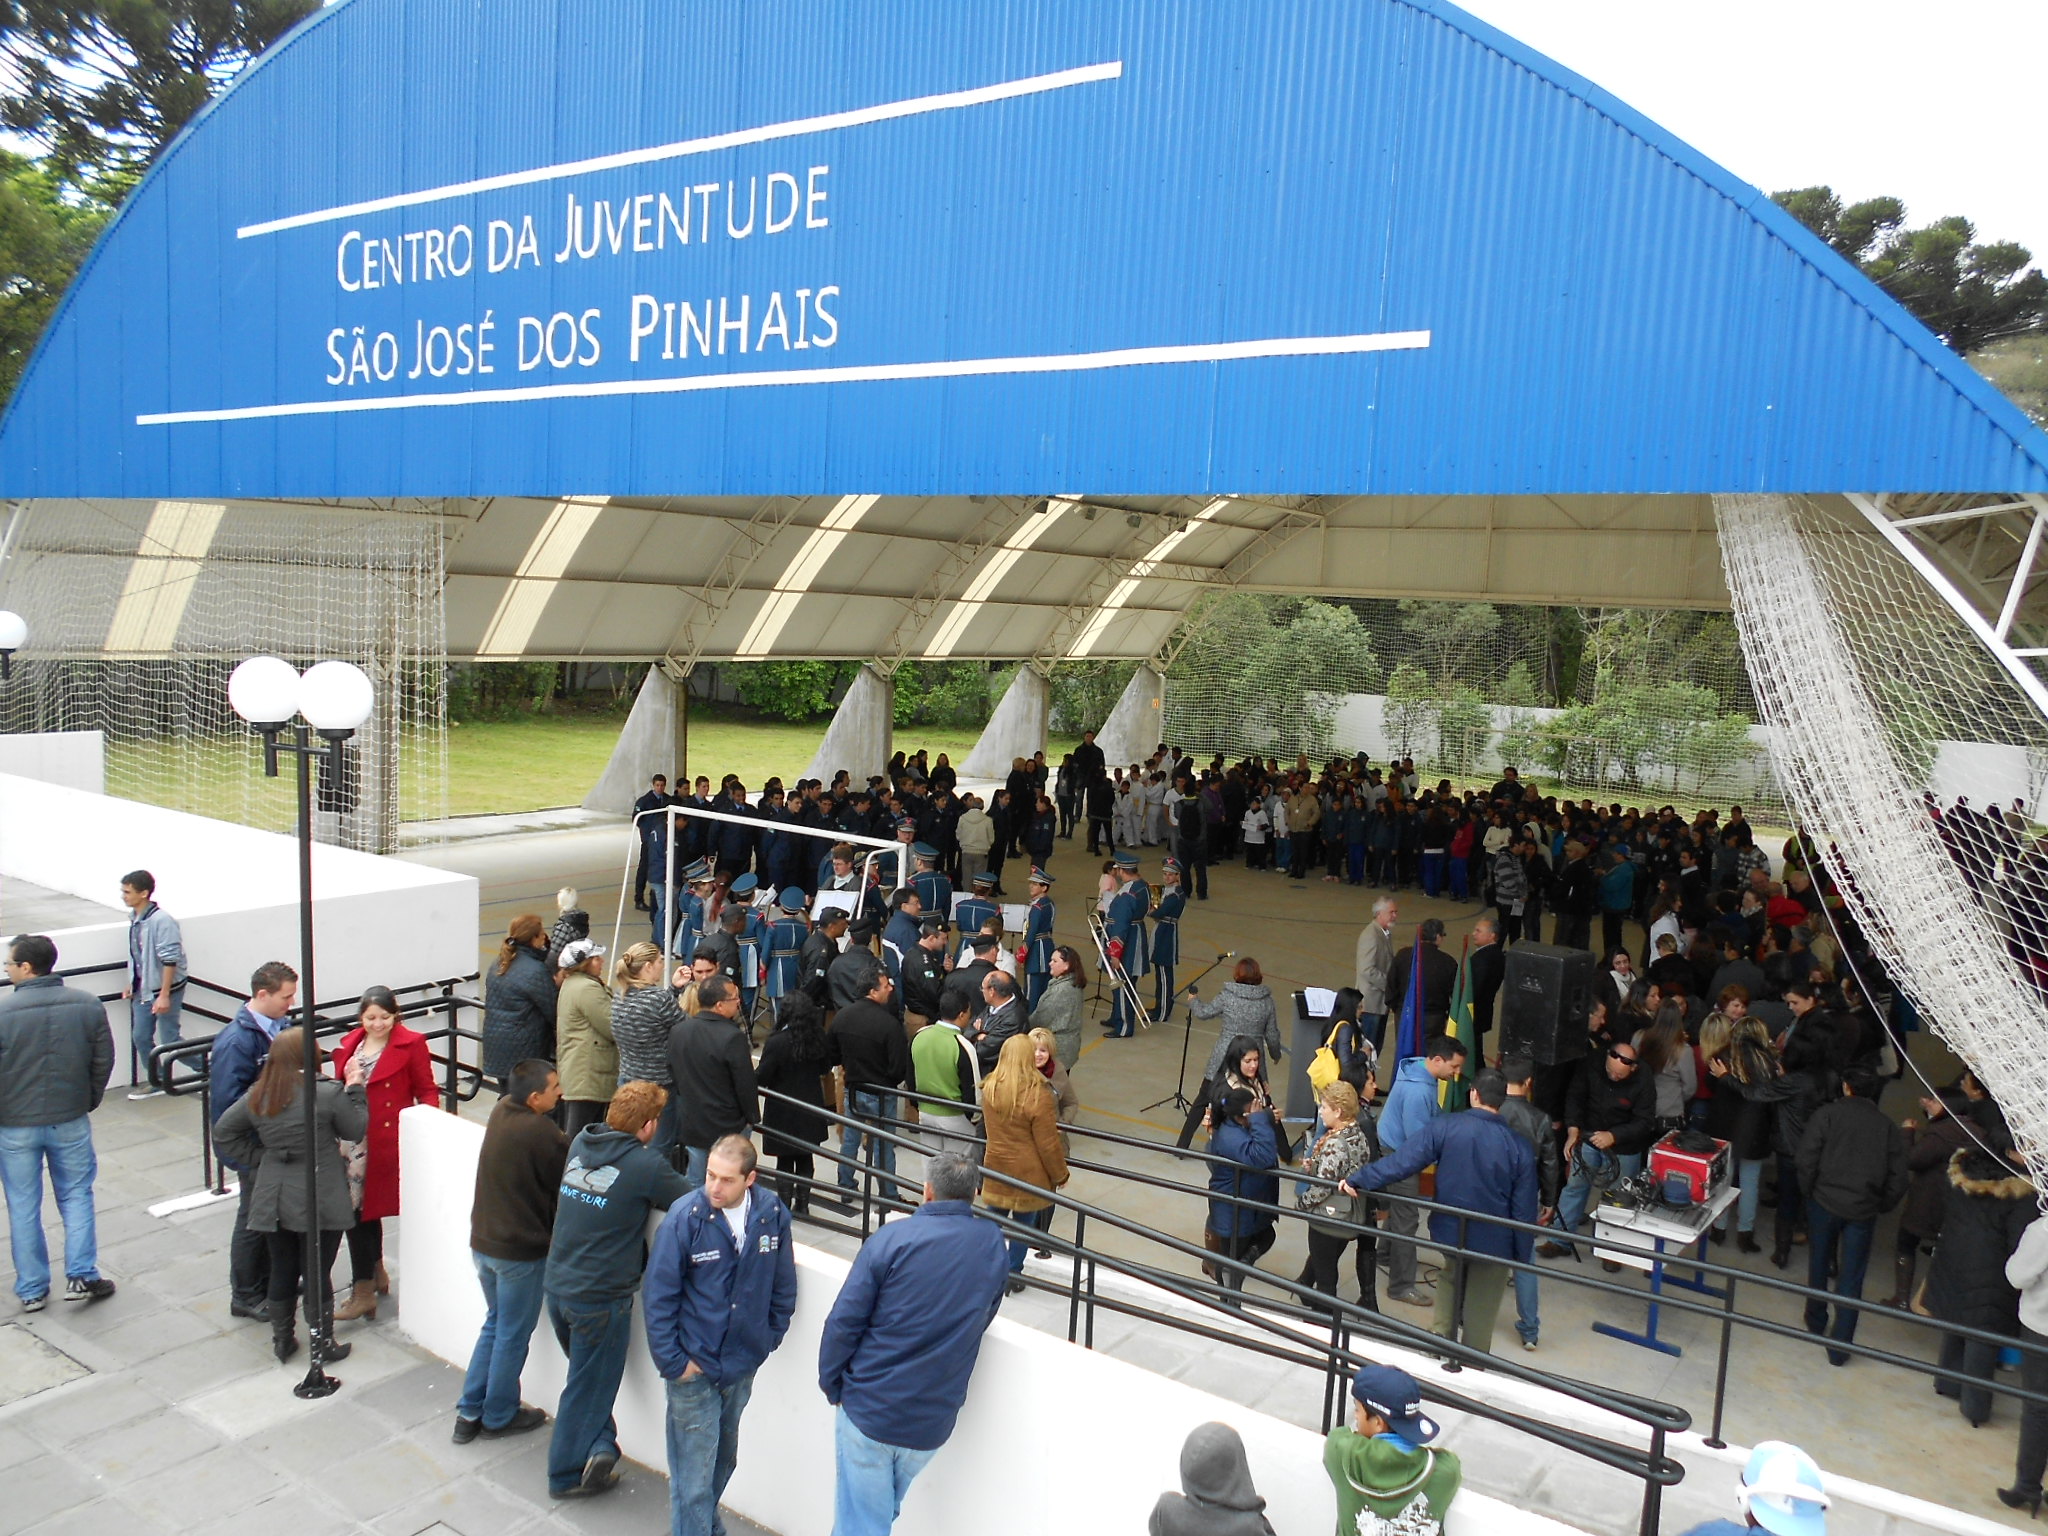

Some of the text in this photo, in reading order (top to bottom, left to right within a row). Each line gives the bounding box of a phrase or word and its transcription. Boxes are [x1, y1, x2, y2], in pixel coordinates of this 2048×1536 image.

[337, 164, 830, 292] CENTRO DA JUVENTUDE
[326, 284, 841, 387] SÃO JOSÉ DOS PINHAIS
[580, 1193, 608, 1210] SURF
